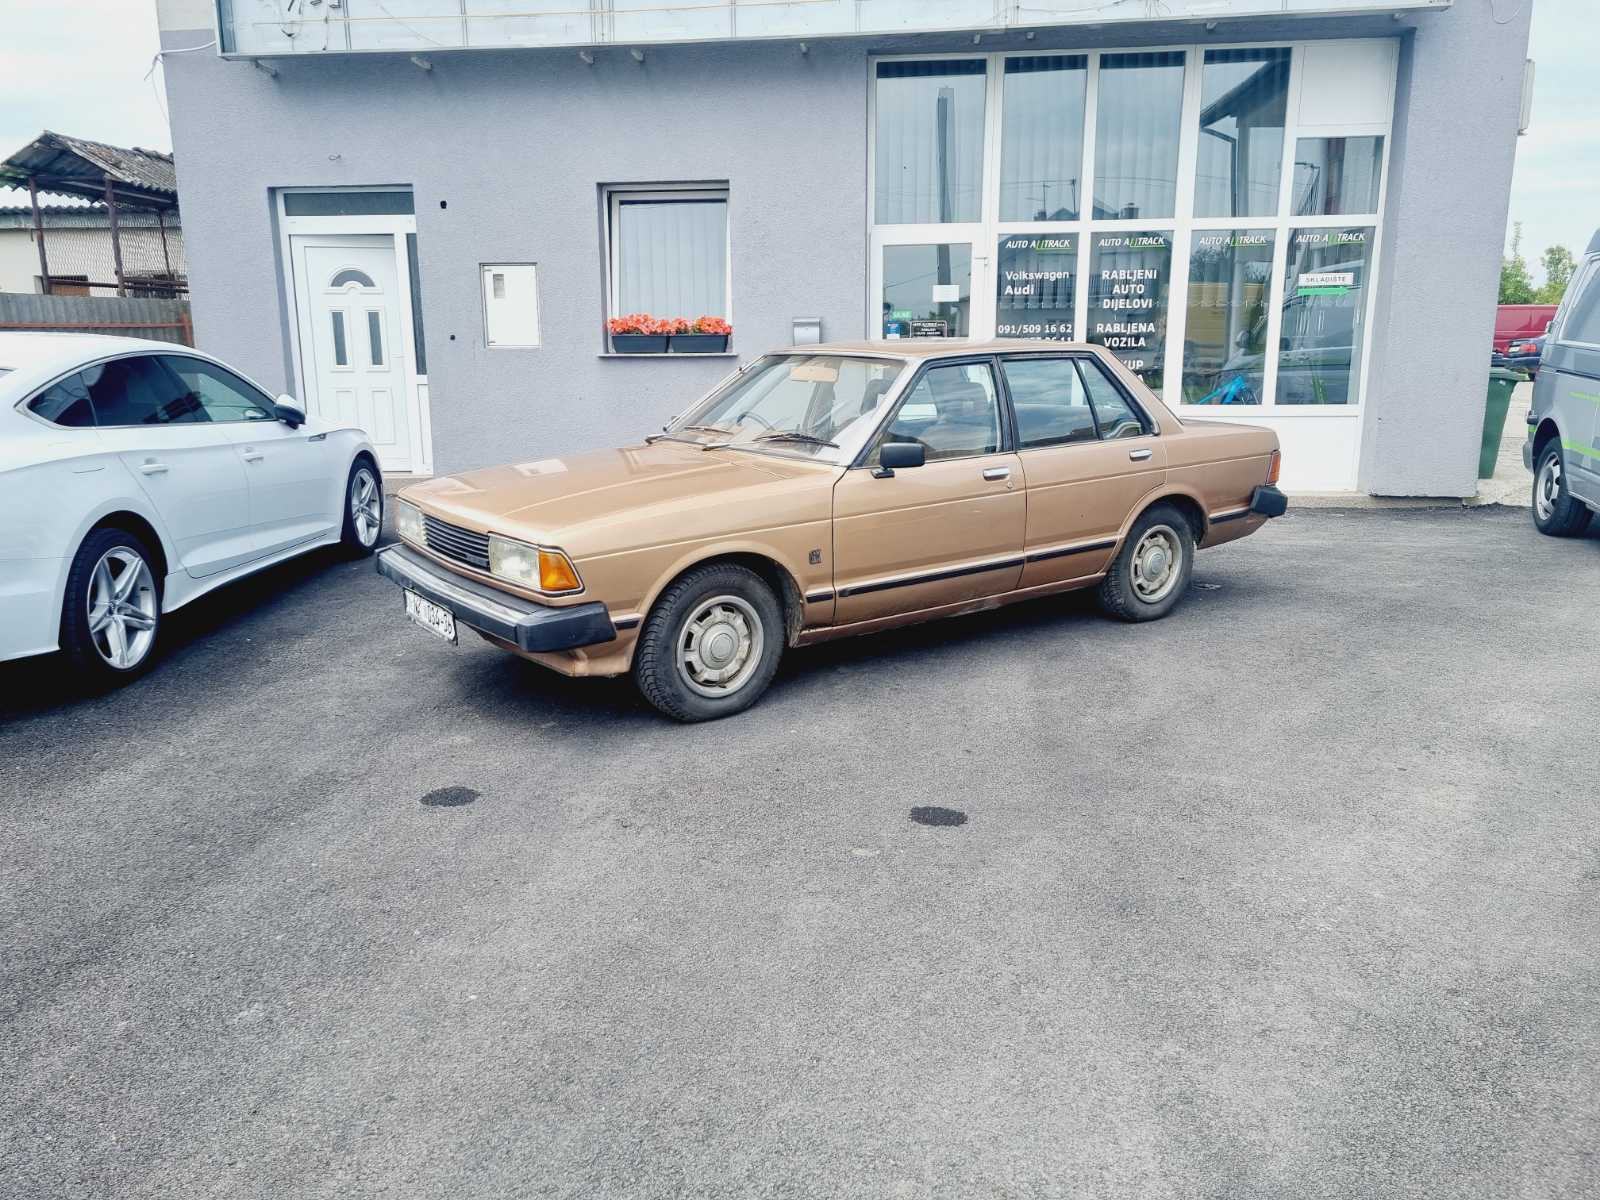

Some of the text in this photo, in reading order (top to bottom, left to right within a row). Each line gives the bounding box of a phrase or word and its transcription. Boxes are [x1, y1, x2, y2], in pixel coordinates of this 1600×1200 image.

[1098, 238, 1121, 247] AUTO
[1199, 236, 1222, 246] AUTO
[1296, 234, 1320, 243] AUTO
[1005, 240, 1028, 249] AUTO
[1005, 271, 1070, 282] Volkswagen
[1101, 269, 1158, 282] RABLJENI
[1004, 284, 1035, 295] Audi
[1112, 284, 1146, 295] AUTO
[1103, 298, 1153, 312] DIJELOVI
[998, 323, 1073, 335] 091/509 16 62
[1096, 322, 1156, 335] RABLJENA
[1104, 336, 1146, 348] VOZILA
